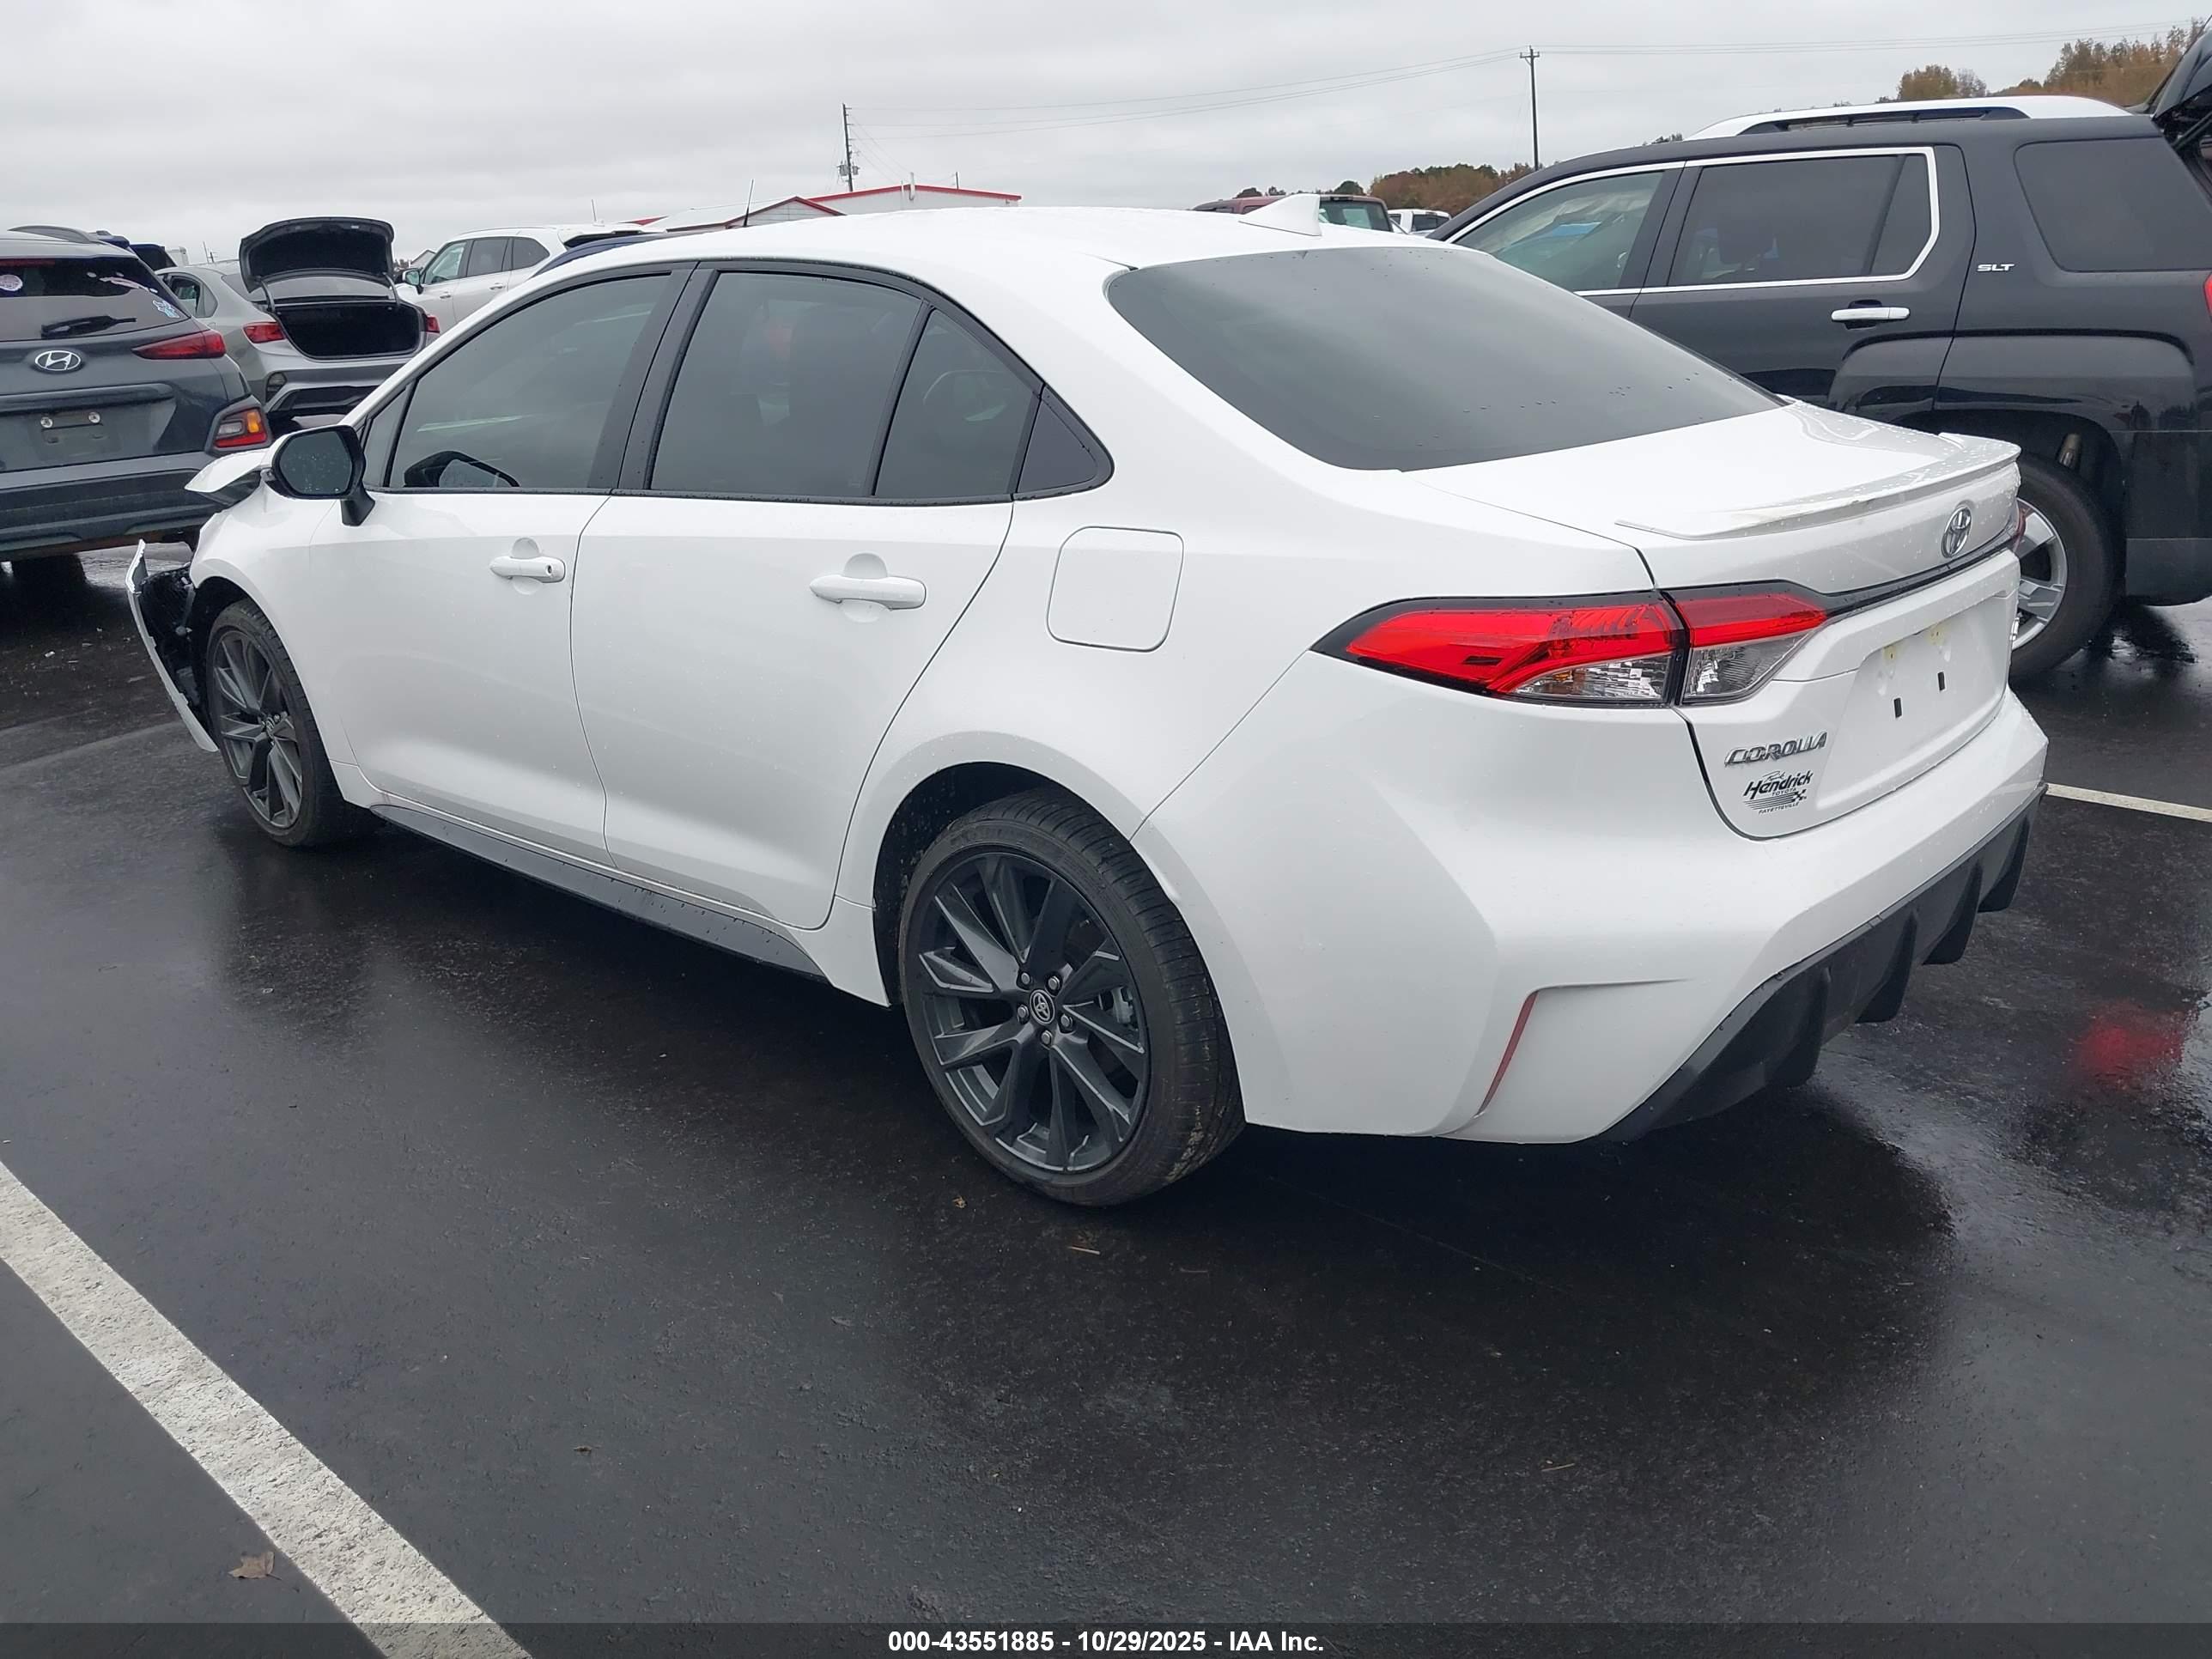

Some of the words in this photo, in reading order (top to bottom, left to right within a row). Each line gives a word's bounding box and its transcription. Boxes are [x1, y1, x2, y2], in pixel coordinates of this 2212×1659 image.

[1724, 731, 1827, 768] COROLLA
[1743, 770, 1814, 800] Hendrick
[1771, 787, 1797, 797] TOYOTA
